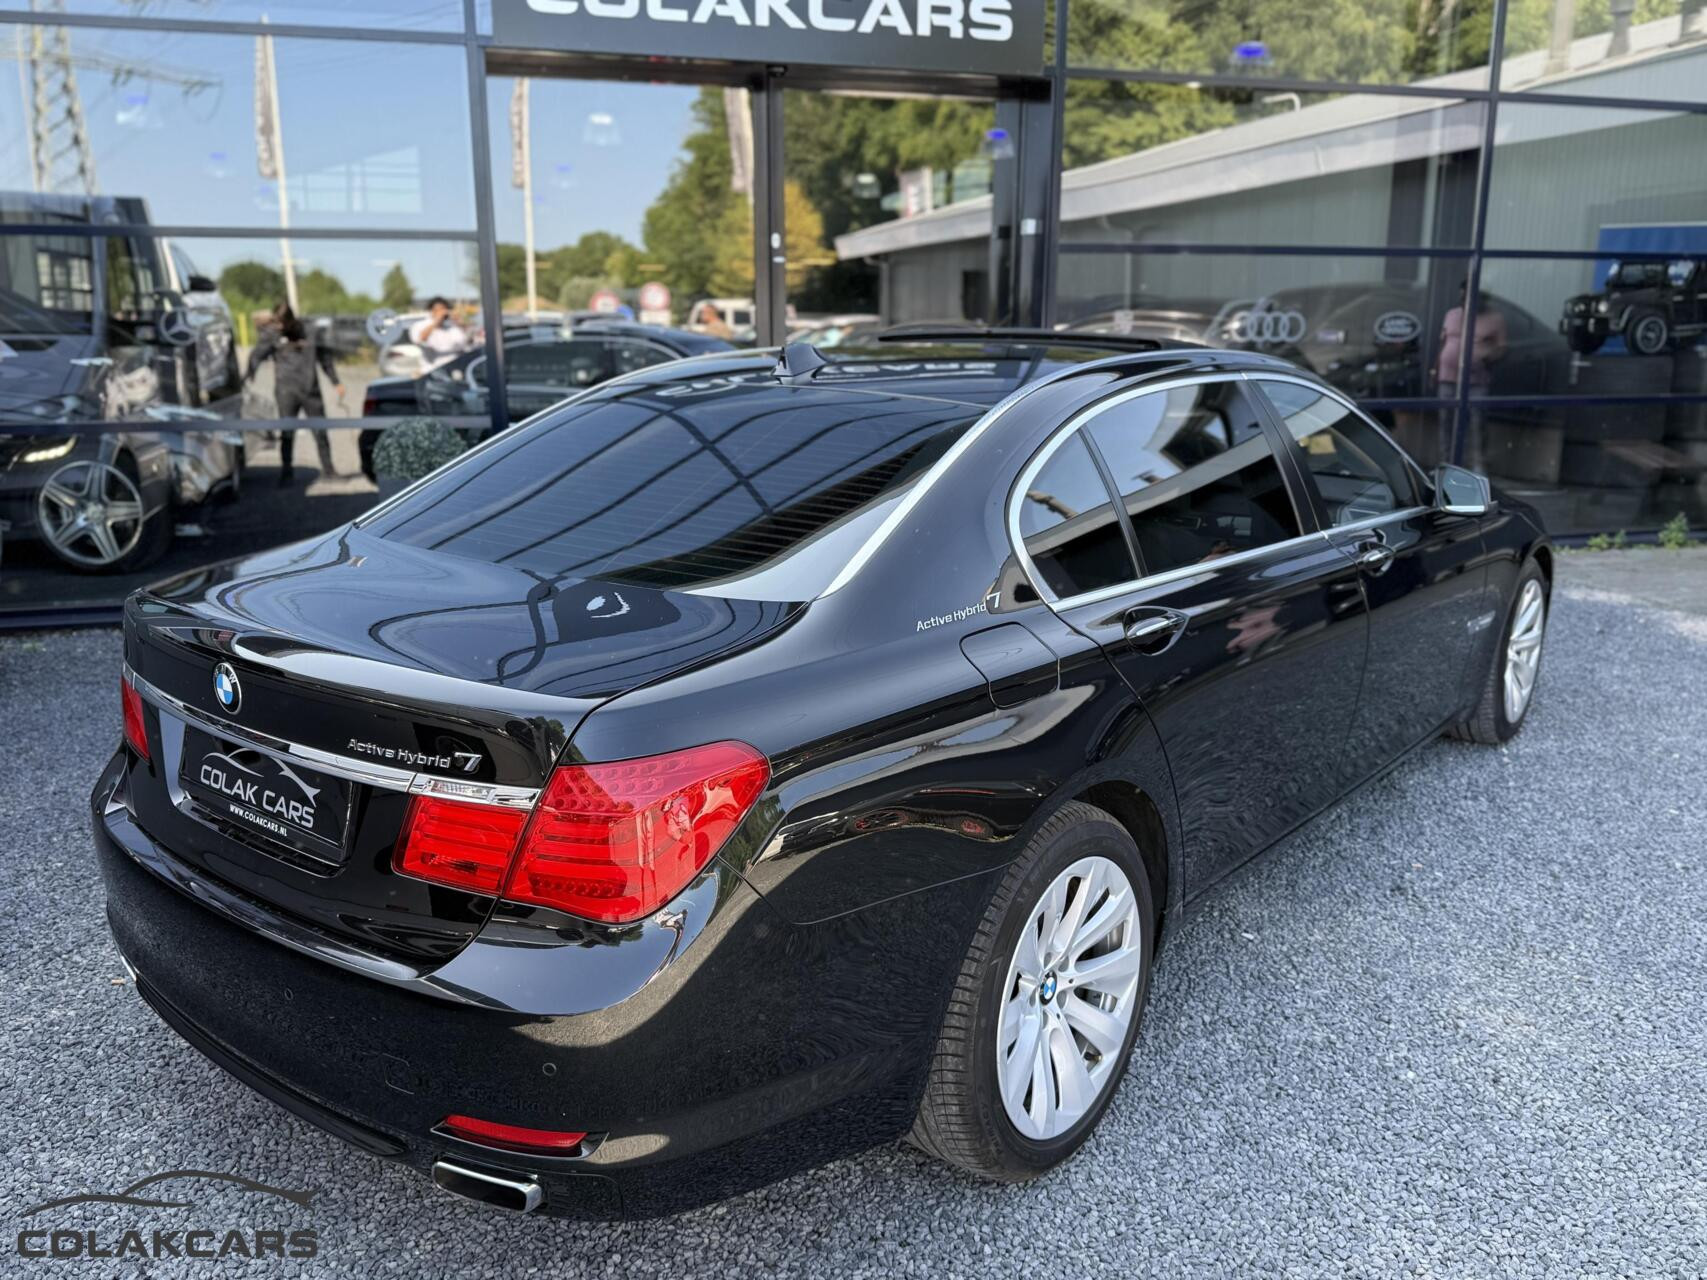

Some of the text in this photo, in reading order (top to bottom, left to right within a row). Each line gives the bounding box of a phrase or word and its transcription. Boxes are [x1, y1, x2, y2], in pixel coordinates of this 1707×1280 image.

[916, 591, 1001, 632] Active Hybrid 7
[347, 738, 483, 772] Active Hybrid 7
[200, 764, 315, 828] COLAK CARS
[229, 803, 288, 837] WWW.COLAKCARS.NL
